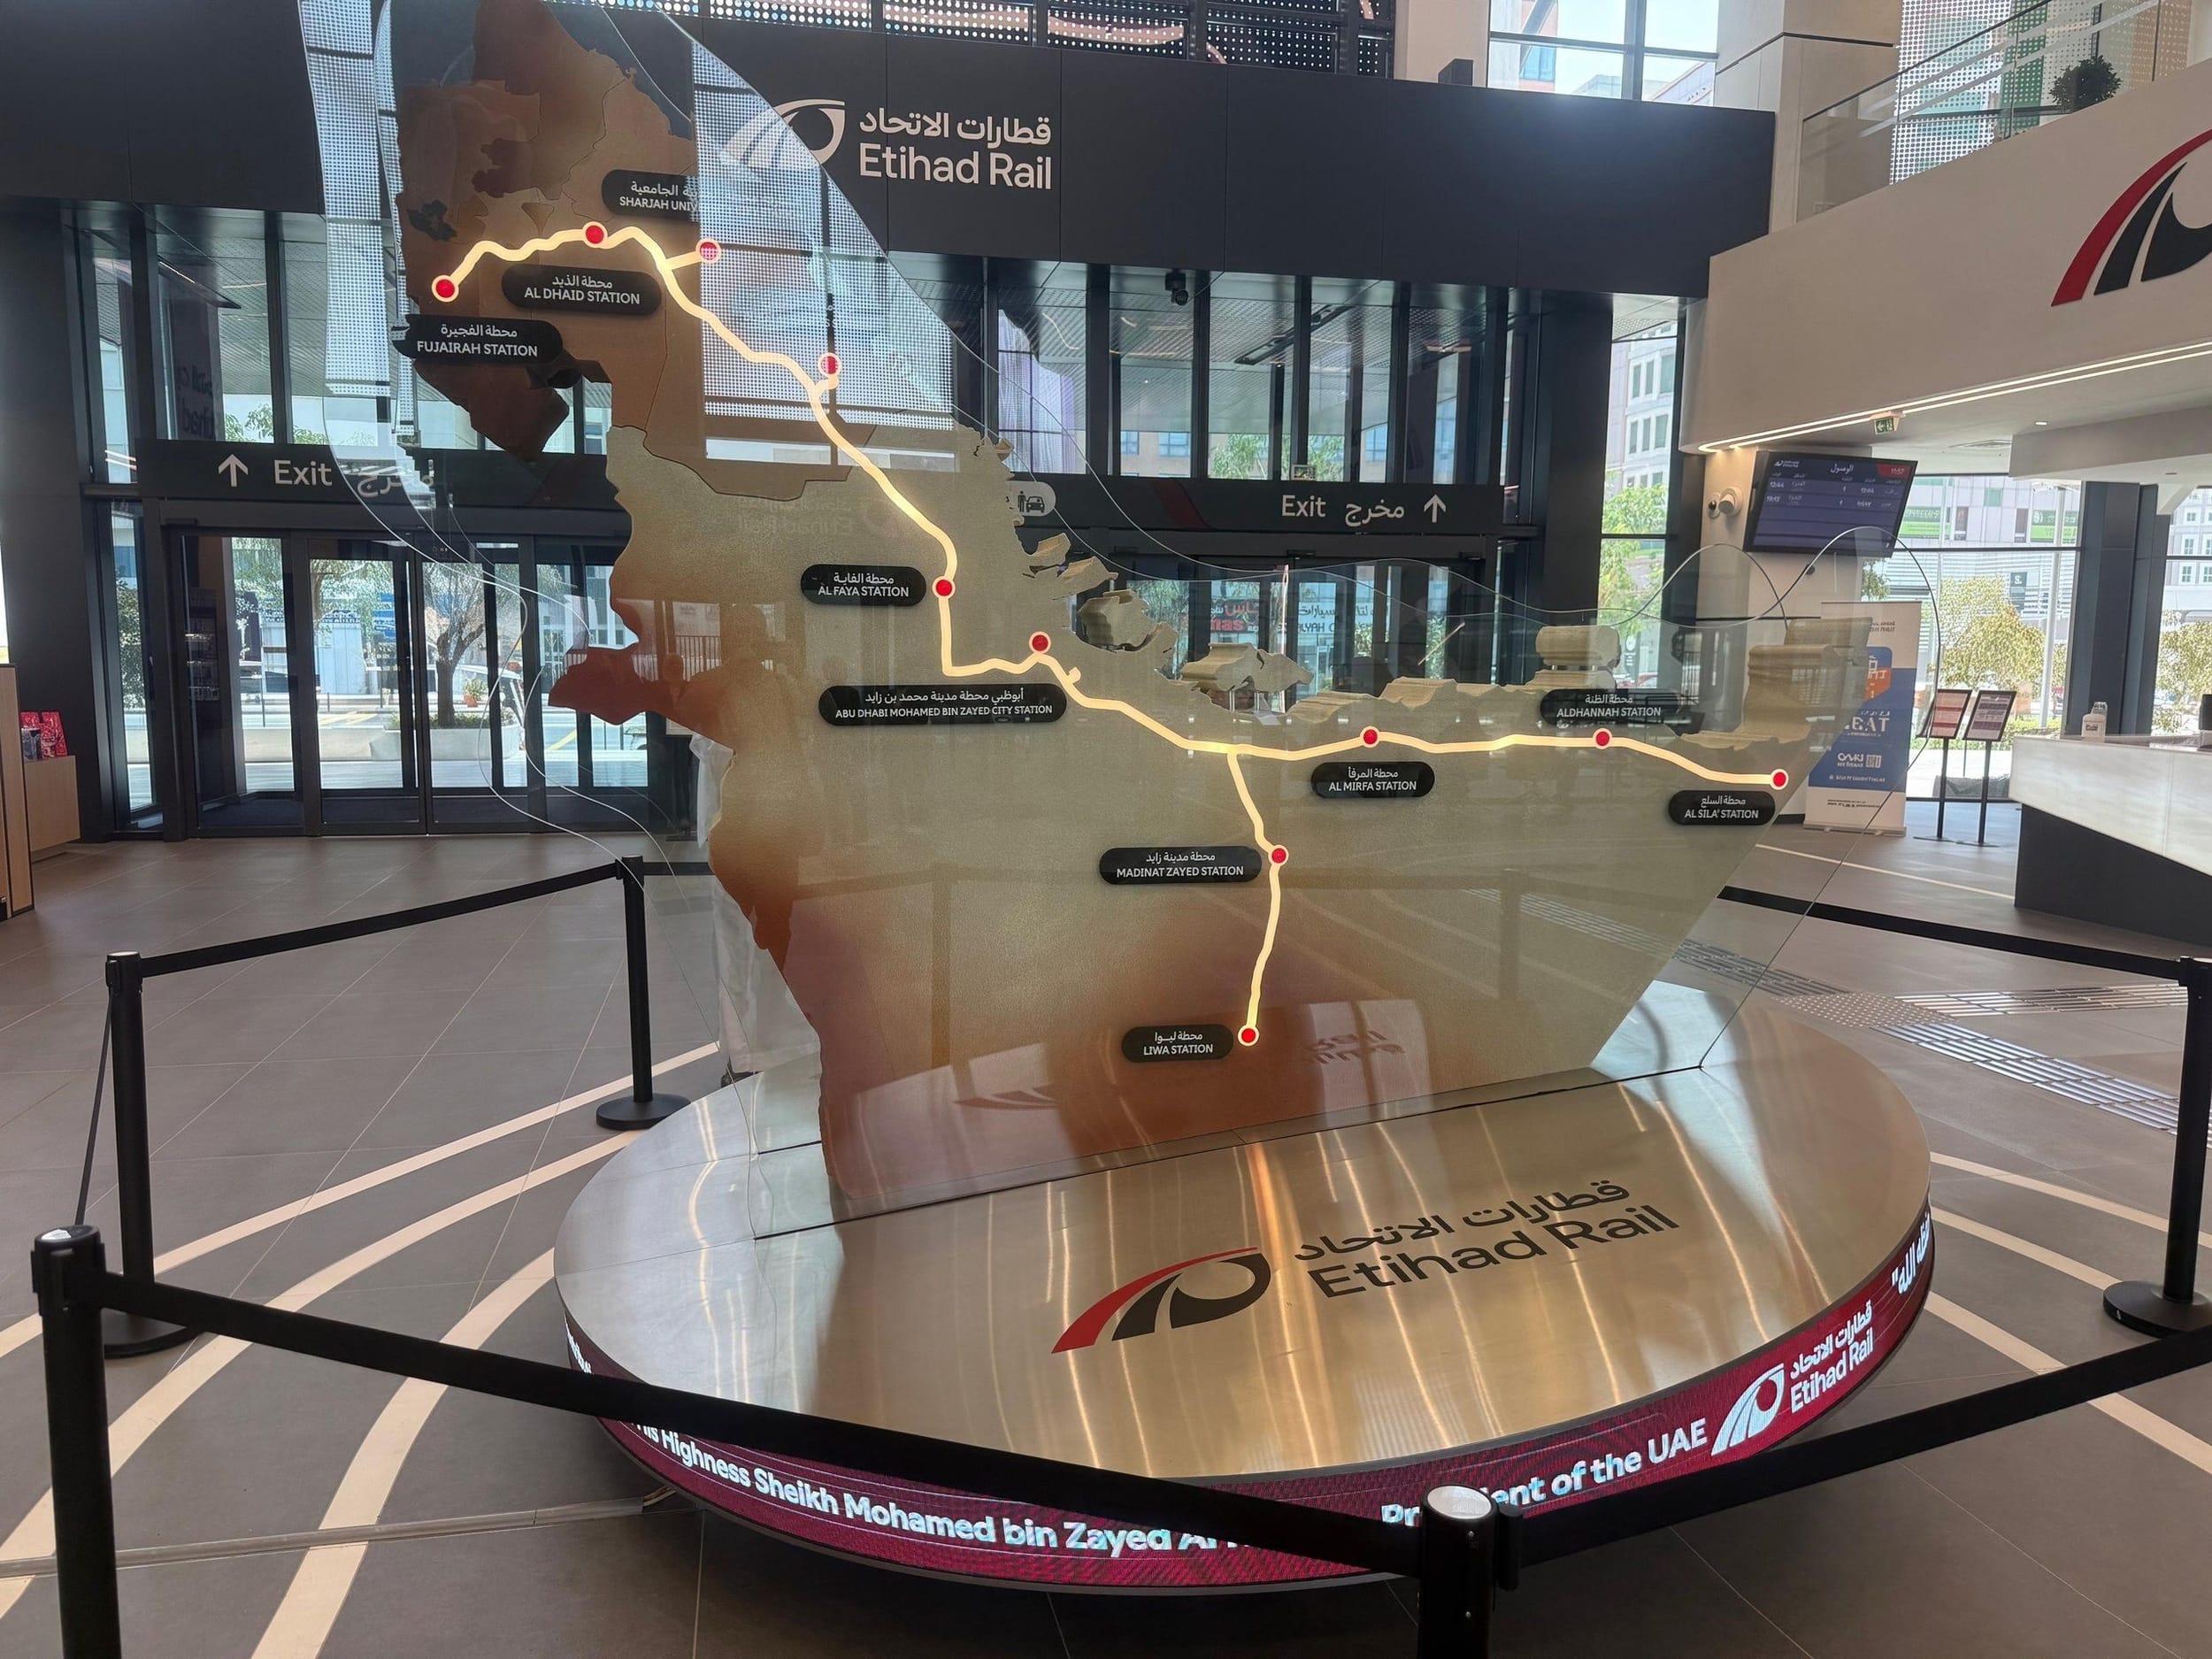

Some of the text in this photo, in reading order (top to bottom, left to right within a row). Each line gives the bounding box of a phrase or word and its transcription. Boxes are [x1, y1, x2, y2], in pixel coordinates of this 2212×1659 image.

[859, 108, 1052, 149] قطارات الاتحاد
[859, 142, 1052, 189] Etihad Rail
[631, 180, 679, 196] الجامعية
[619, 196, 668, 210] SHARJAH
[552, 274, 612, 288] محطة الذيد
[524, 288, 640, 304] AL DHAID STATION
[441, 324, 518, 338] محطة الفجيرة
[417, 341, 537, 357] FUJAIRAH STATION
[273, 459, 333, 486] Exit
[1282, 495, 1326, 517] Exit
[1345, 499, 1405, 526] مخرج
[866, 572, 895, 585] محطة
[818, 587, 910, 597] AL FAYA STATION
[865, 687, 1025, 704] أبوظبي محطة مدينة محمد بن زايد
[1585, 694, 1633, 703] محطة الظنة
[835, 705, 1053, 718] ABU DHABI MOHAMED BIN ZAYED CITY STATION
[1621, 707, 1661, 717] STATION
[1348, 766, 1399, 780] محطة المرفأ
[1329, 780, 1417, 791] AL MIRFA STATION
[1701, 795, 1746, 809] محطة السلع
[1685, 810, 1759, 818] AL SILA' STATION
[1146, 851, 1215, 864] محطة مدينة زايد
[1117, 865, 1244, 878] MADINAT ZAYED STATION
[1179, 1031, 1202, 1041] محطة
[1143, 1044, 1213, 1056] LIWA STATION
[1294, 1179, 1630, 1260] قطارات الاتحاد
[1308, 1204, 1679, 1298] Etihad Rail
[1790, 1299, 1872, 1379] قطارات الاتحاد
[1791, 1326, 1873, 1413] Etihad Rail
[661, 1429, 751, 1488] Highness
[753, 1468, 839, 1516] Sheikh
[843, 1493, 995, 1543] Mohamed
[1002, 1517, 1057, 1548] bin
[1064, 1522, 1171, 1557] Zayed
[1551, 1461, 1586, 1496] of
[1591, 1450, 1642, 1484] the
[1647, 1417, 1708, 1464] UAE
